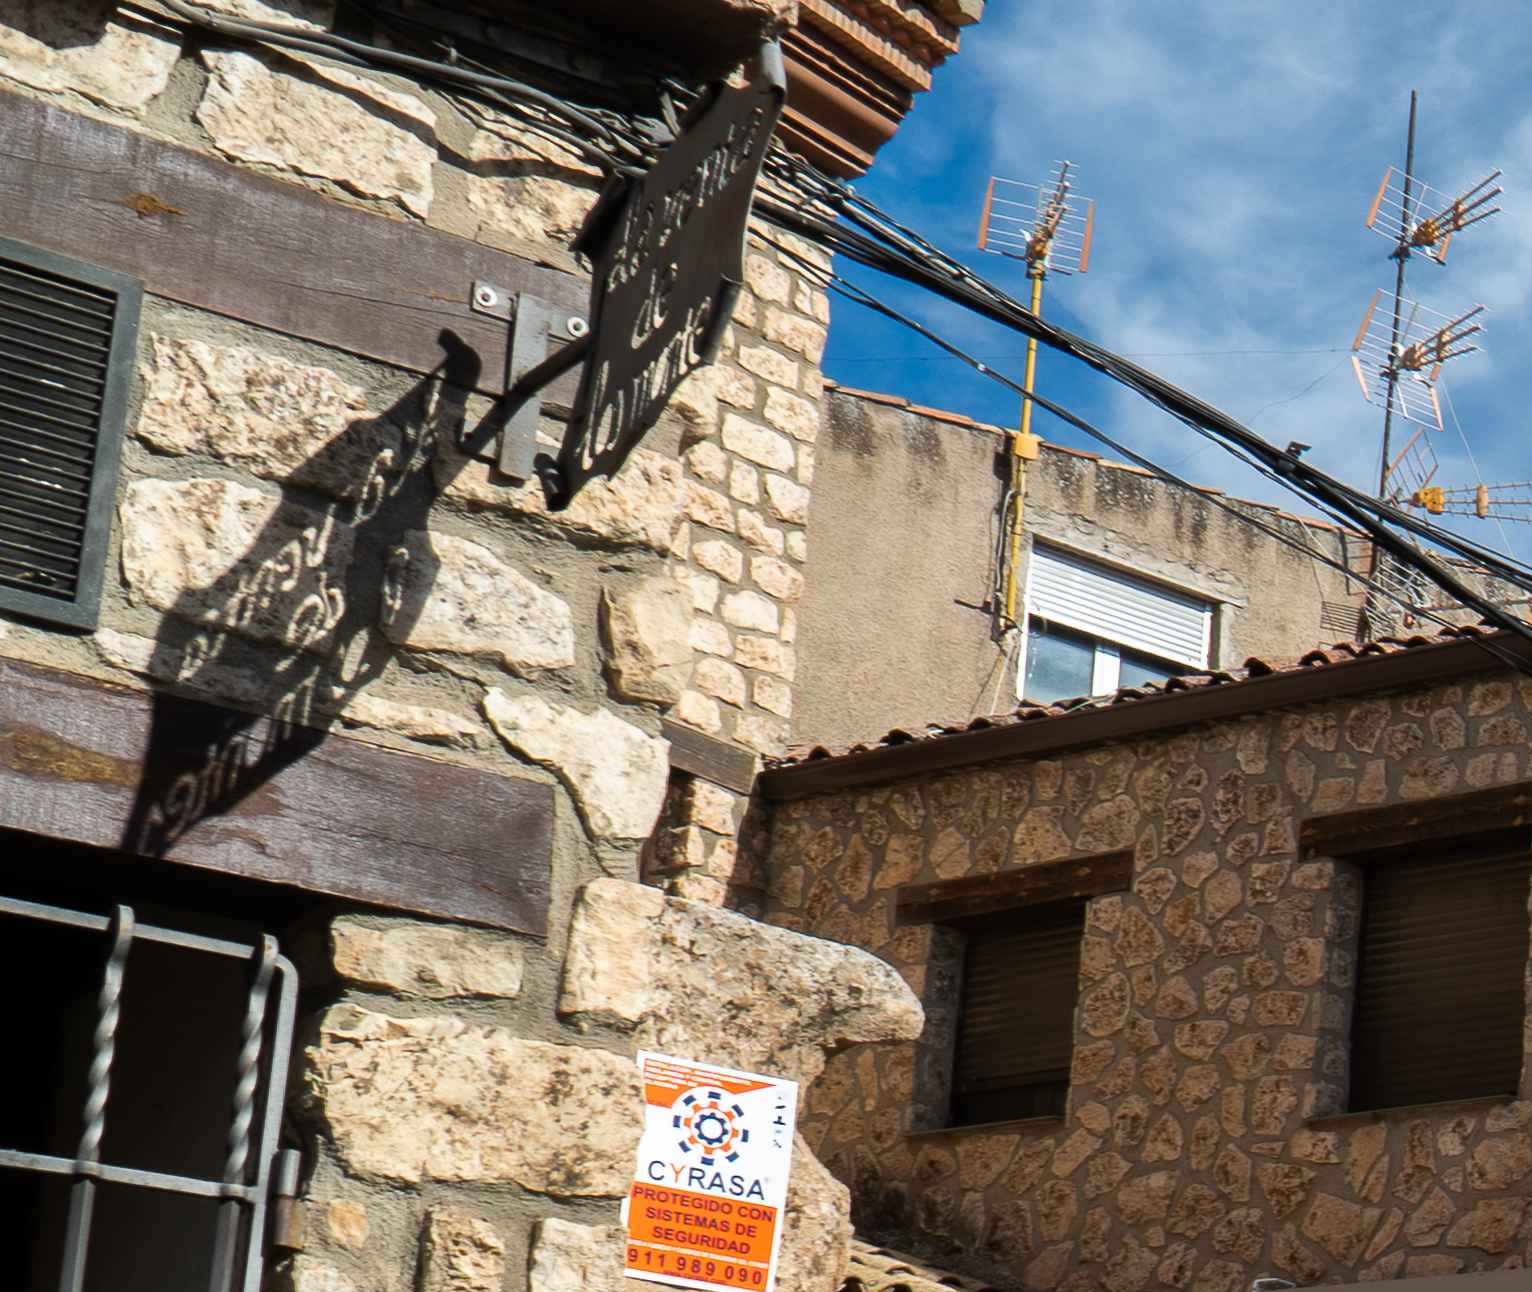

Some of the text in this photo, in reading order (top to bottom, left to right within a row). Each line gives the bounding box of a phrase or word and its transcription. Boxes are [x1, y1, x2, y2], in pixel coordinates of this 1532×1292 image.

[648, 1159, 765, 1201] CYRASA
[632, 1186, 773, 1223] PROTEGIDO CON
[645, 1206, 758, 1238] SISTEMAS DE
[652, 1226, 751, 1255] SEGURIDAD
[626, 1248, 666, 1268] 911
[676, 1256, 716, 1277] 989
[724, 1265, 763, 1286] 090
